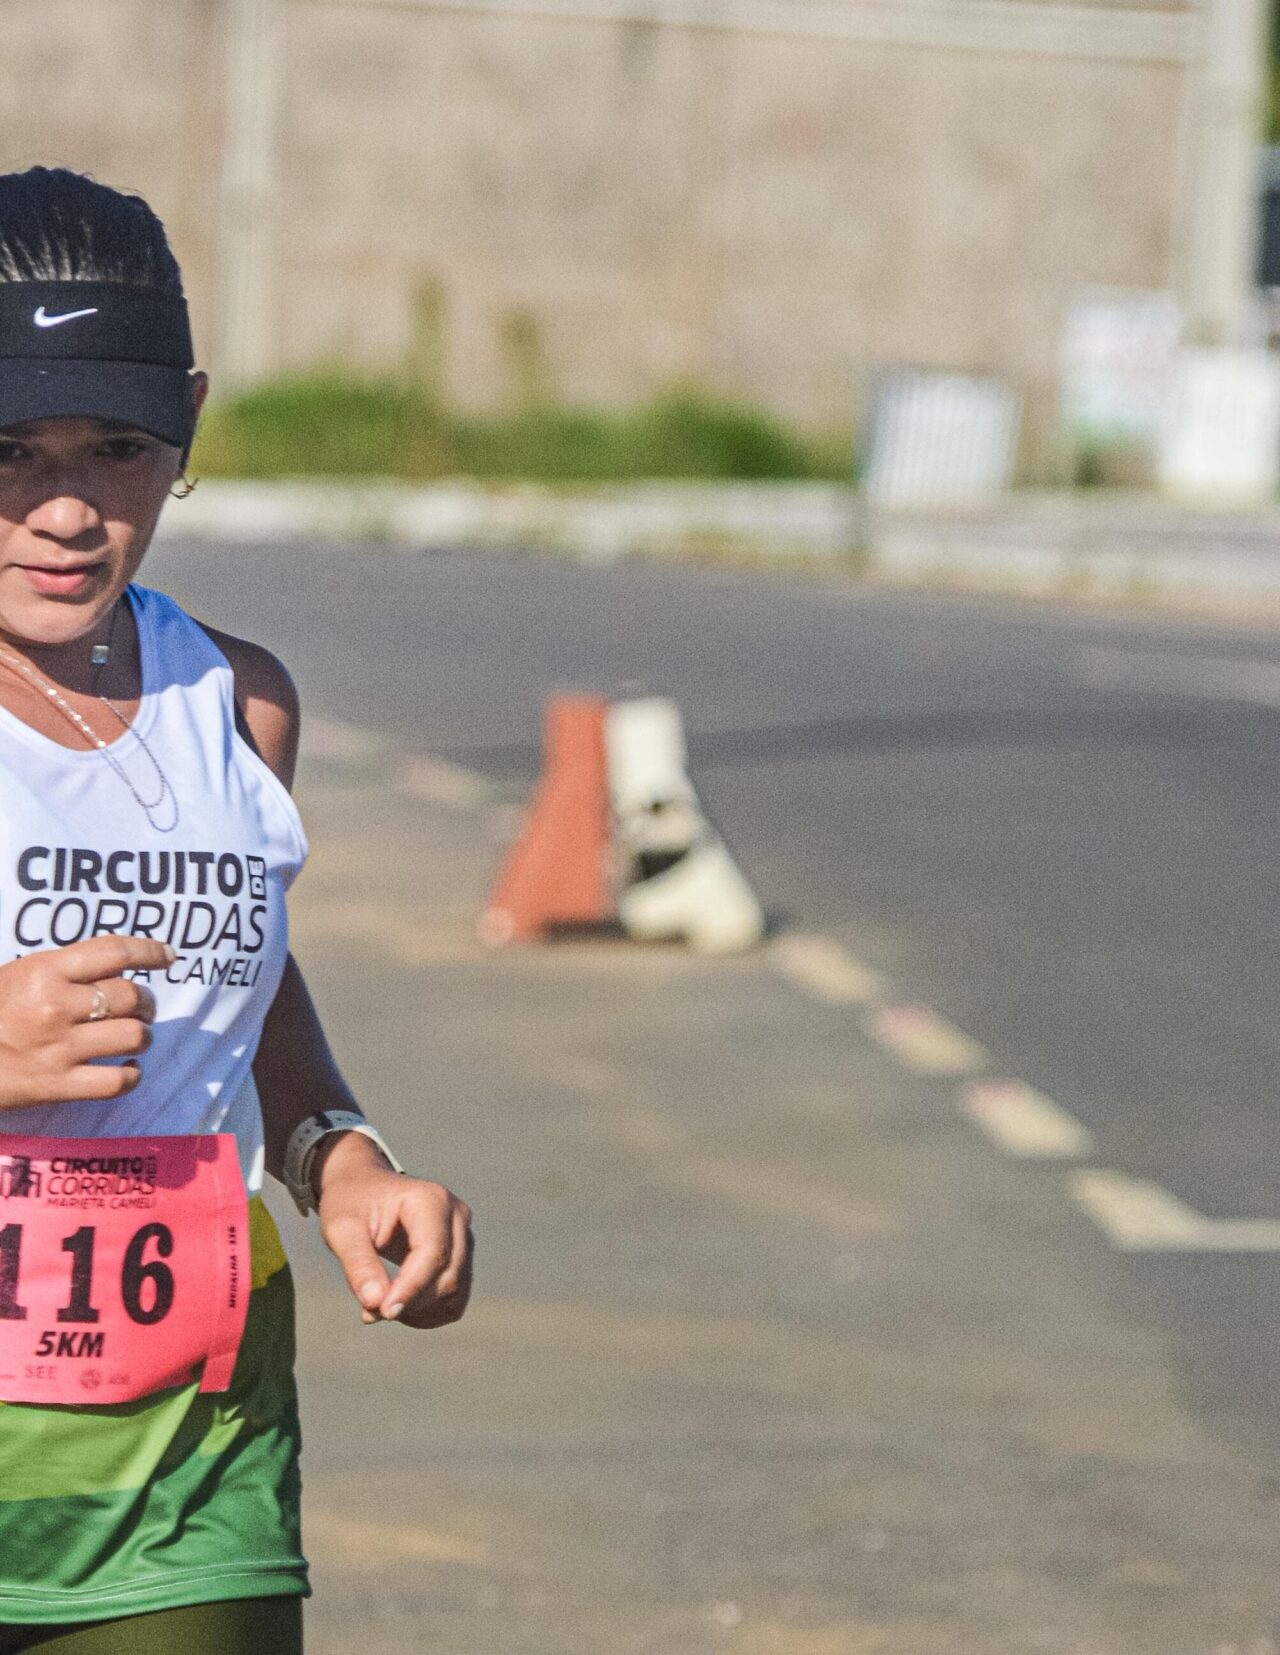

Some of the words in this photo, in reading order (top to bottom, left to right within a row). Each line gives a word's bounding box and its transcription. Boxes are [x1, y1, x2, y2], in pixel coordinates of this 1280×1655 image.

[17, 846, 243, 897] CIRCUITO
[246, 855, 267, 900] DE
[15, 897, 267, 953] CORRIDAS
[166, 956, 263, 987] CAMELI
[50, 1157, 144, 1175] CIRCUITO
[48, 1176, 156, 1195] CORRIDAS
[35, 1331, 106, 1358] 5KM
